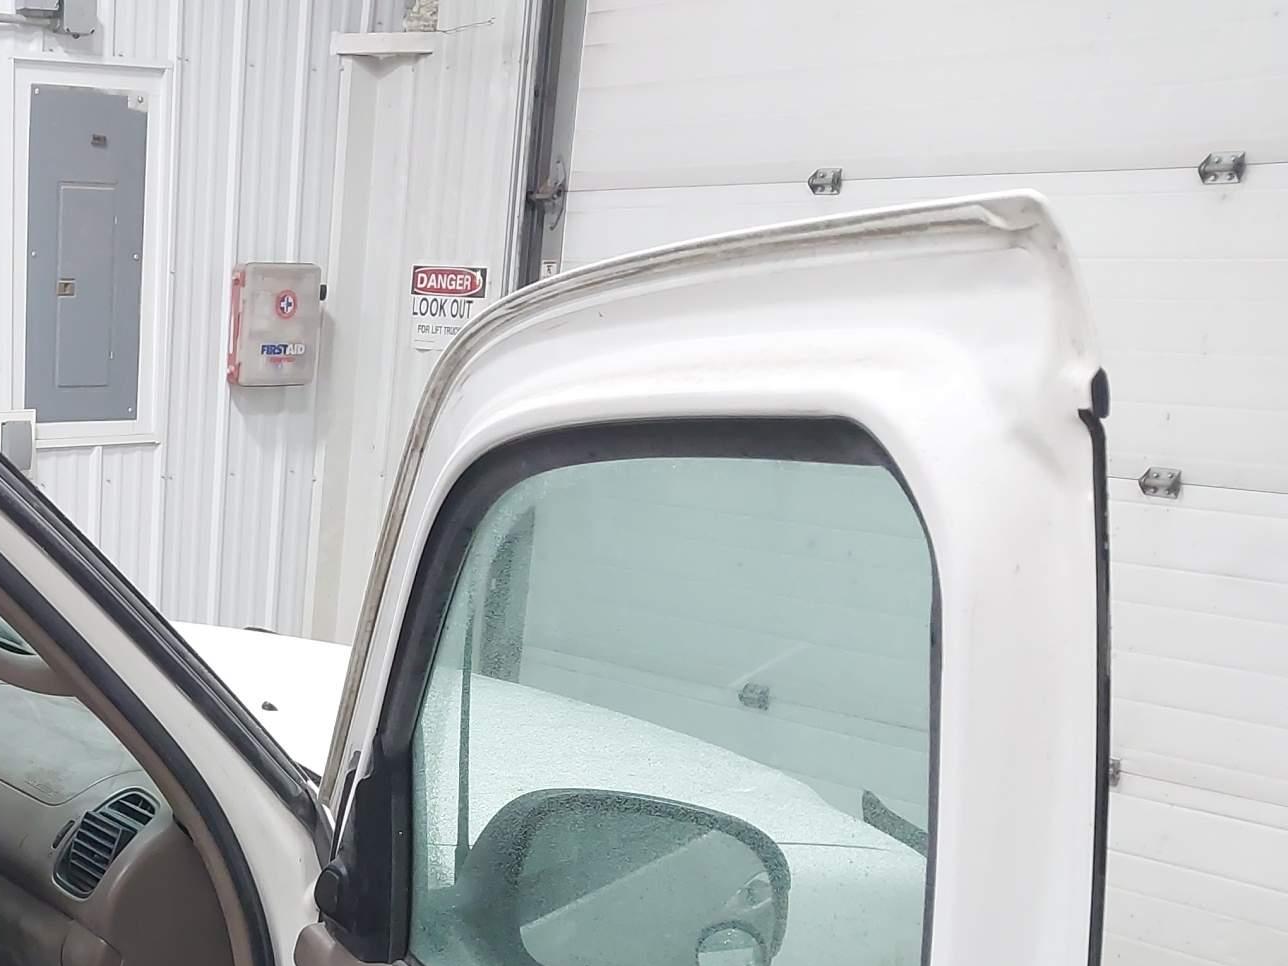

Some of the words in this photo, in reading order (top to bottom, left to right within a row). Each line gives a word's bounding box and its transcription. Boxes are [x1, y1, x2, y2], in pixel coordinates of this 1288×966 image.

[416, 273, 472, 290] DANGER
[412, 297, 446, 317] LOOK
[450, 299, 474, 319] OUT
[417, 324, 430, 334] FOR
[431, 325, 443, 335] LIFT
